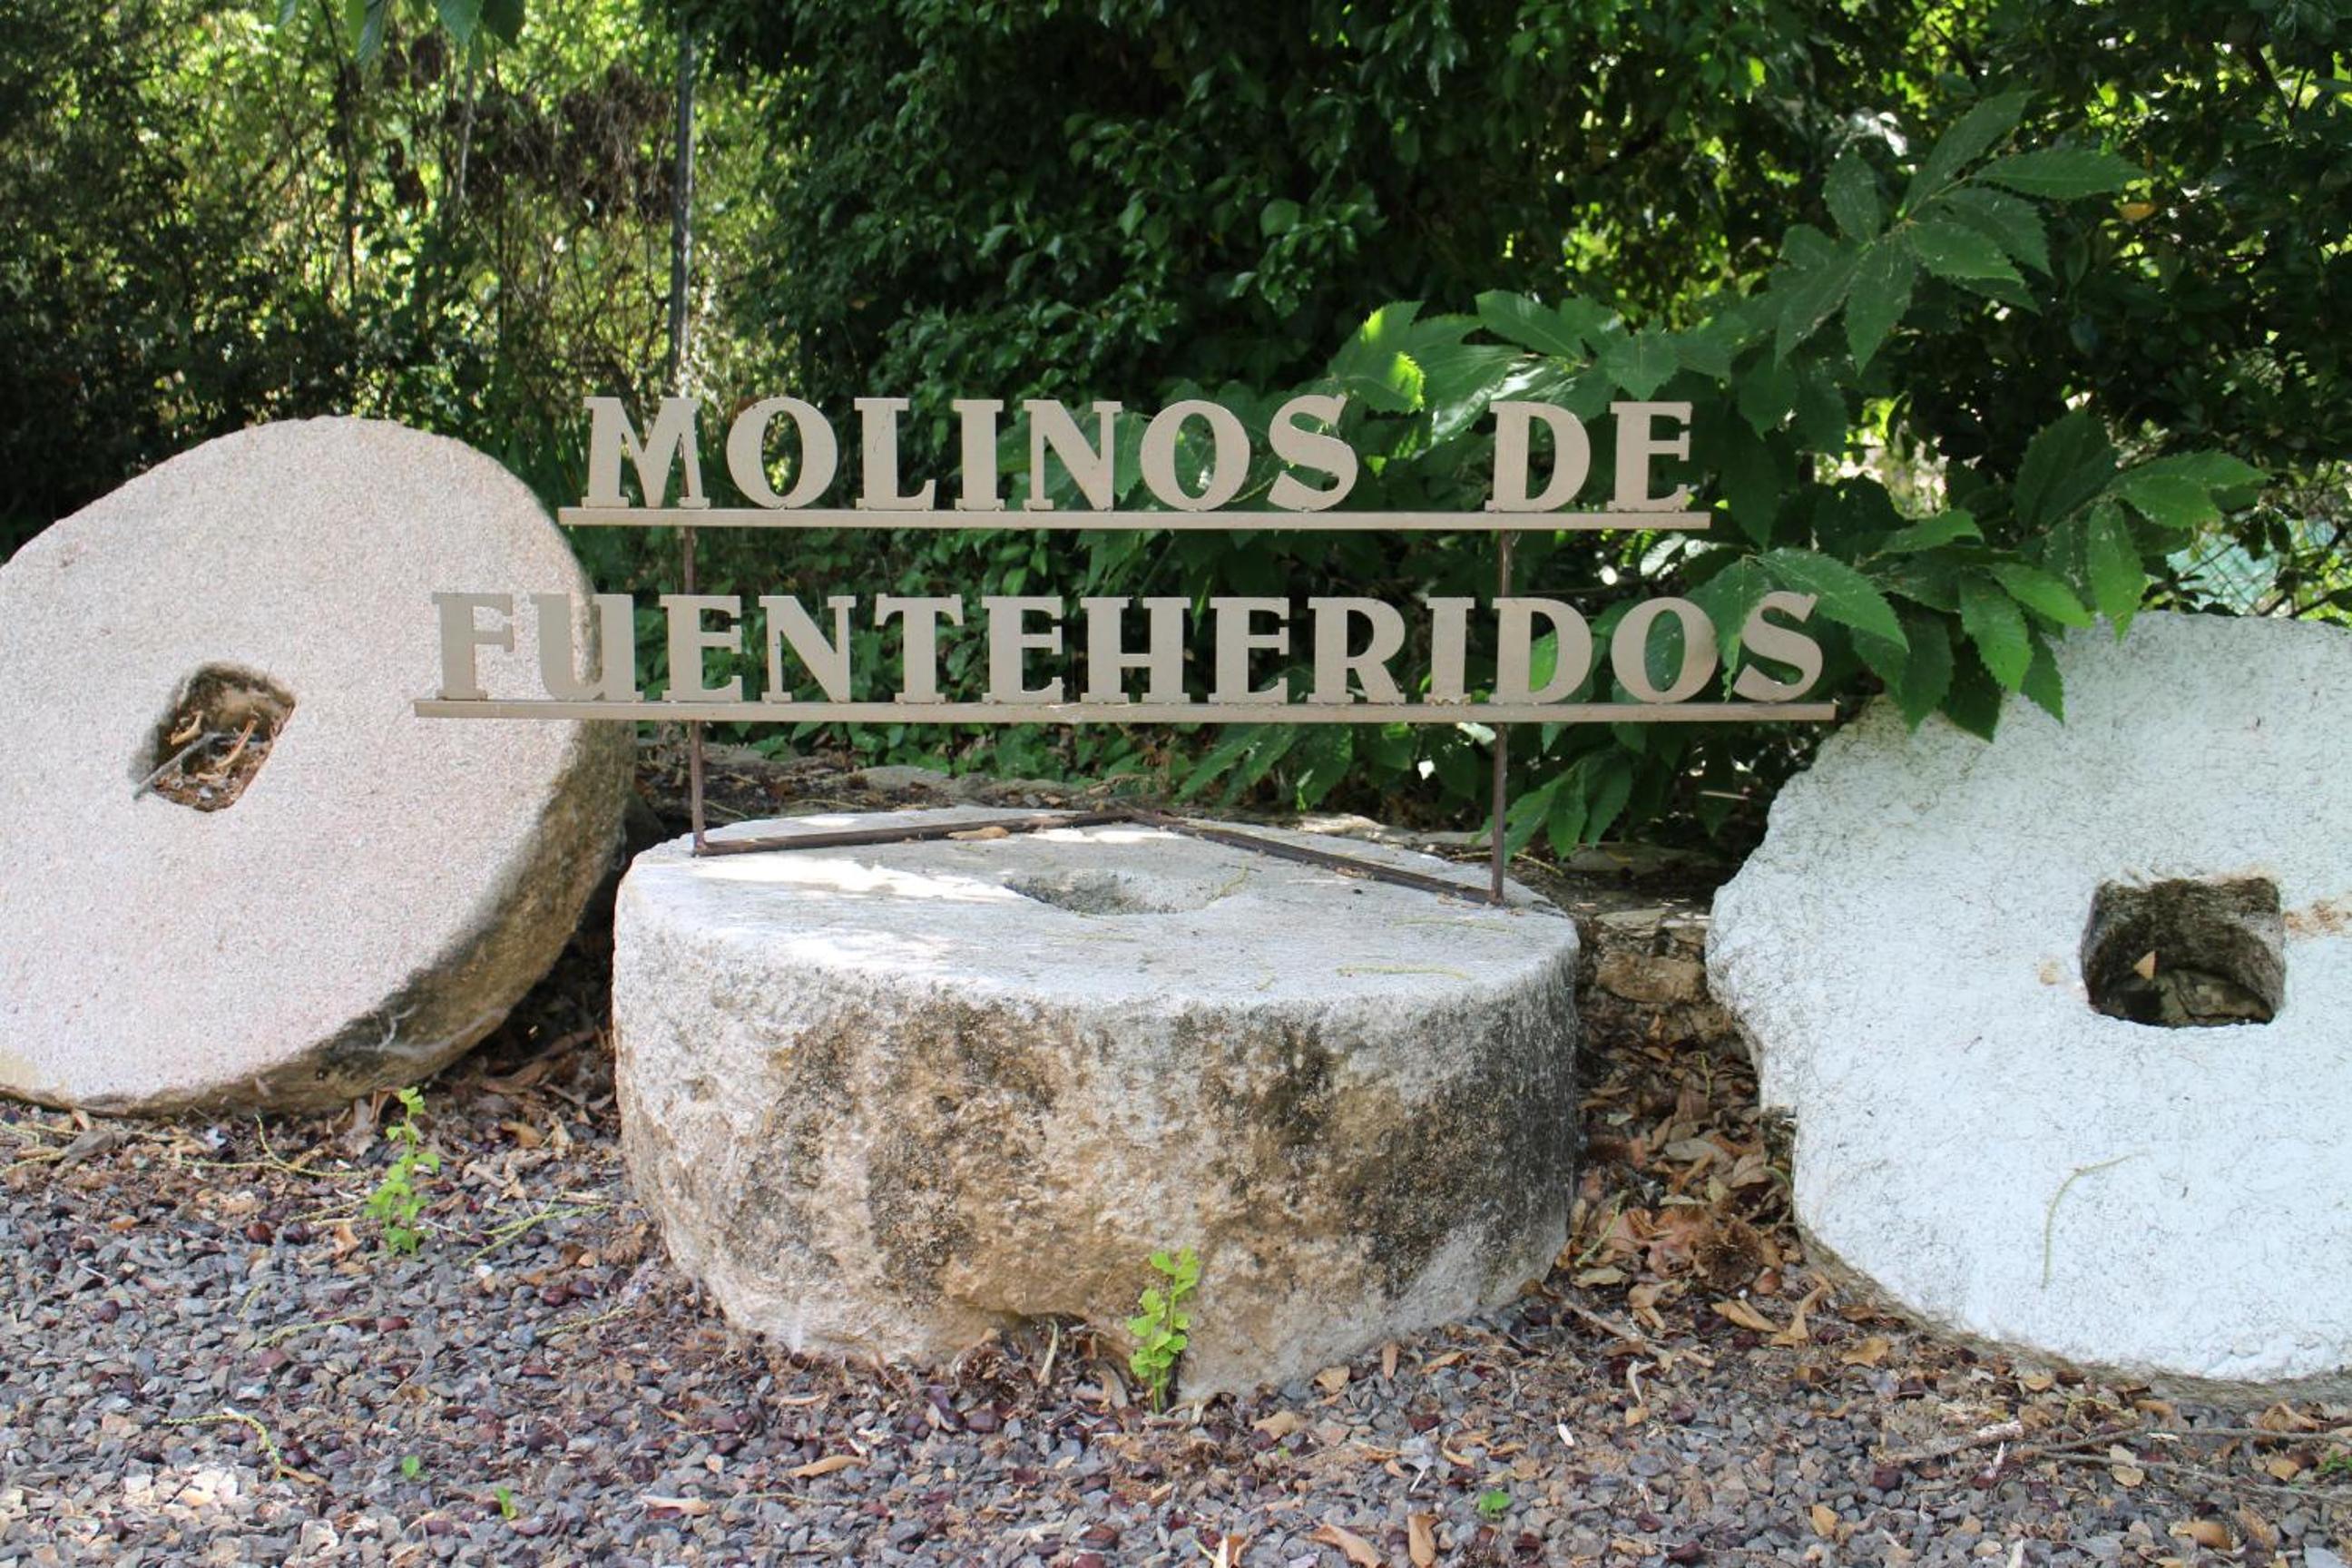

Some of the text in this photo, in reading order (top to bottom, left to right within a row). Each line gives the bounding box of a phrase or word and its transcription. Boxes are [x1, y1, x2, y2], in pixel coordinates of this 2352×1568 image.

[582, 394, 1692, 513] MOLINOS DE
[431, 591, 1824, 704] FUENTEHERIDOS
